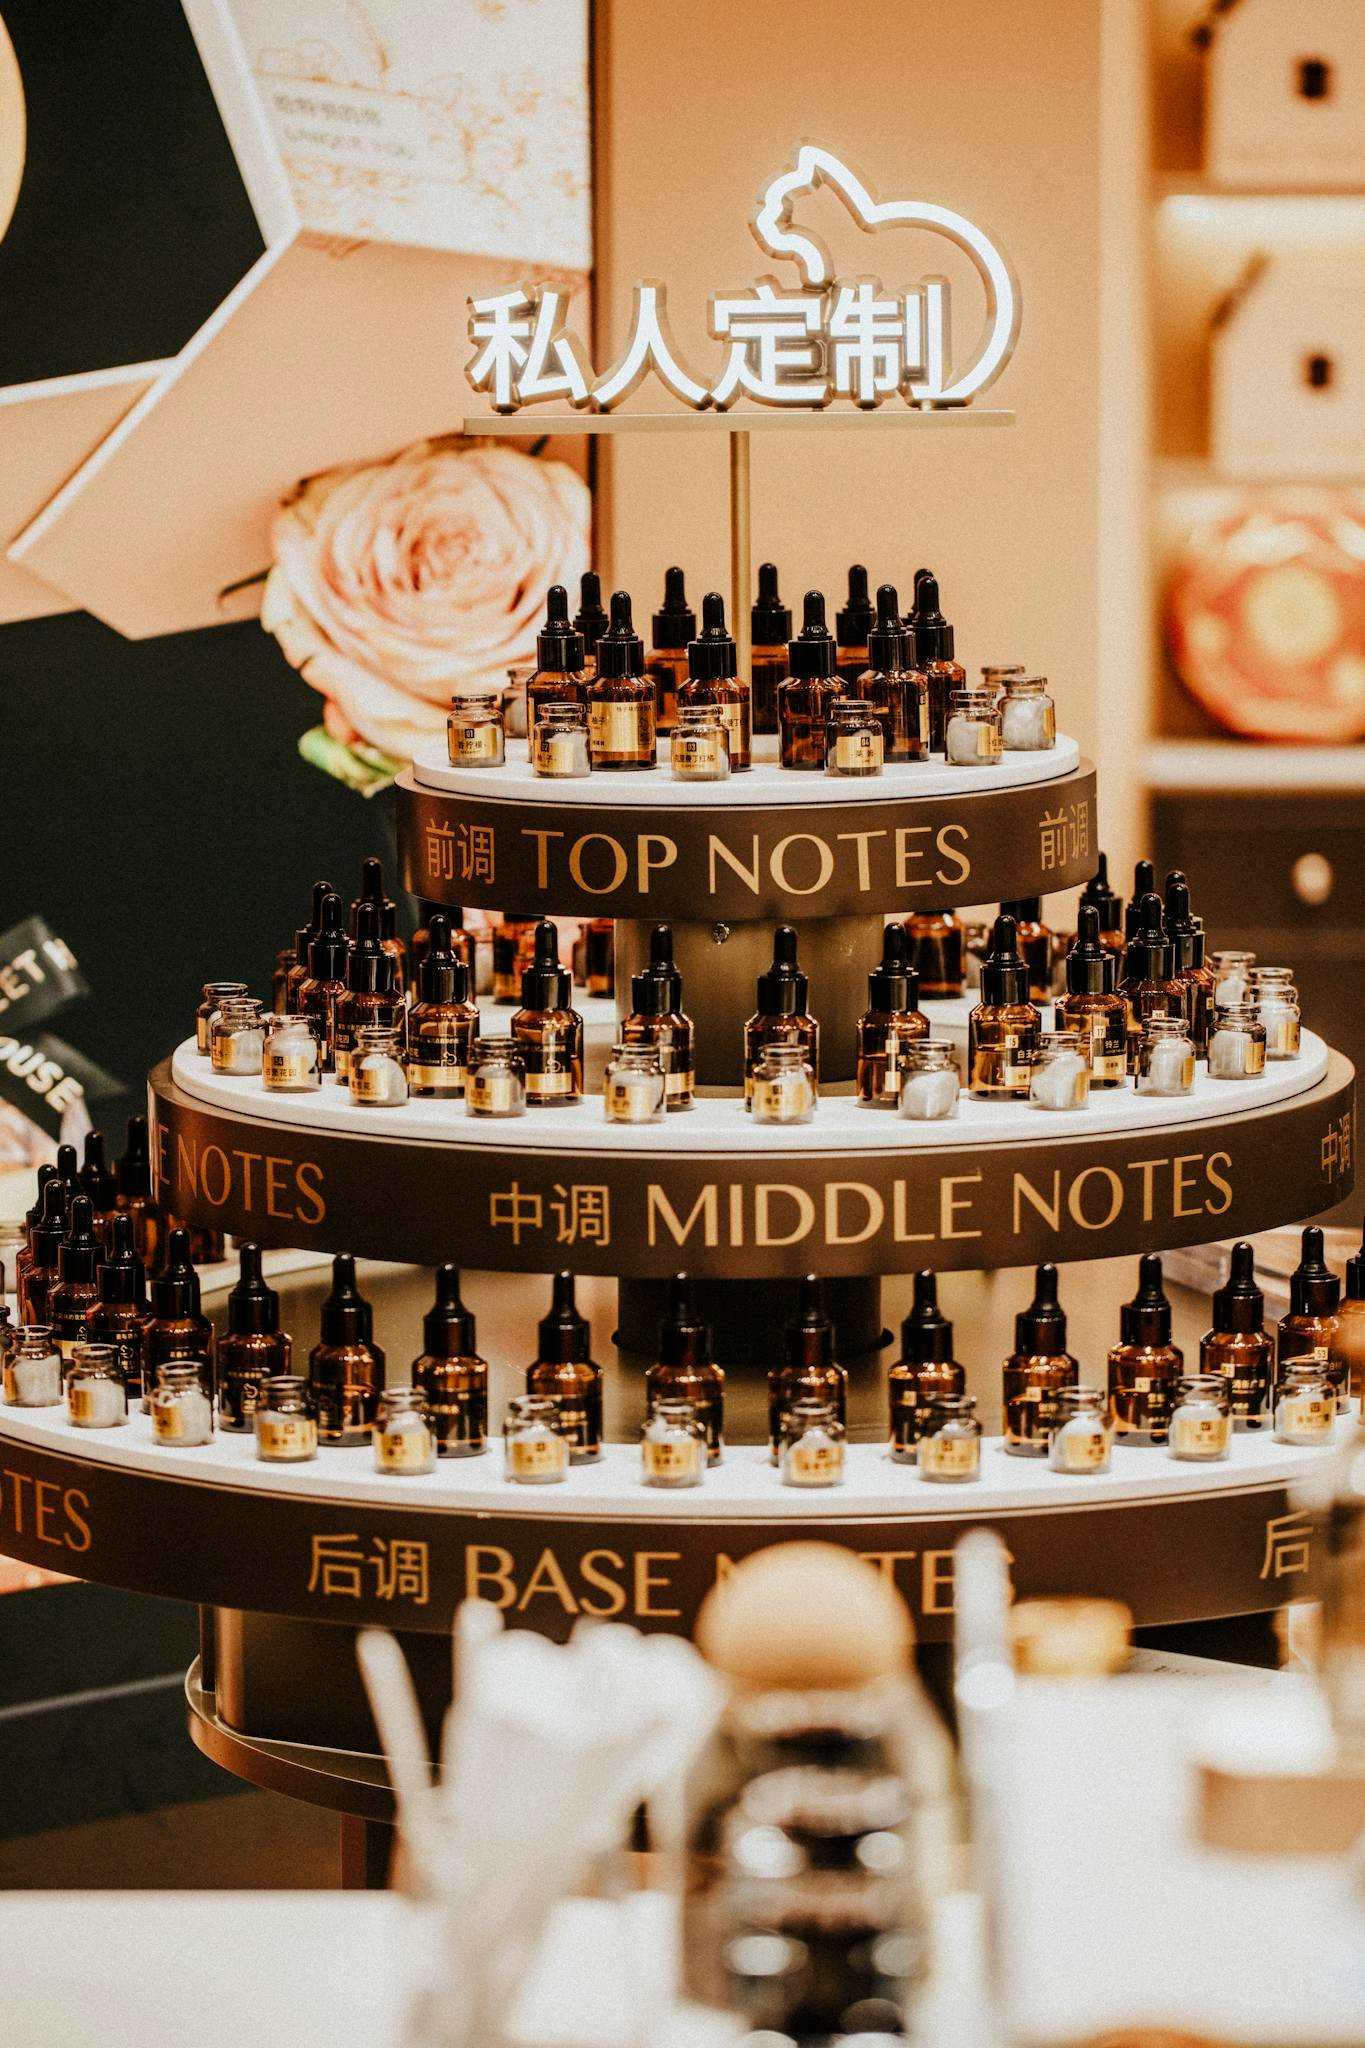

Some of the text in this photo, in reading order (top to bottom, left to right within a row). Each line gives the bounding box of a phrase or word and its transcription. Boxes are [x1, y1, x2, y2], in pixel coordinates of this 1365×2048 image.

[470, 284, 944, 403] 私人定制
[425, 818, 970, 895] 前调 TOP NOTES
[1038, 801, 1089, 871] 前调
[178, 1134, 326, 1225] NOTES
[1321, 1113, 1351, 1184] 中调
[489, 1151, 1233, 1247] 中调 MIDDLE NOTES
[0, 1468, 92, 1552] TES
[308, 1533, 429, 1604] 后调
[465, 1545, 682, 1618] BASE
